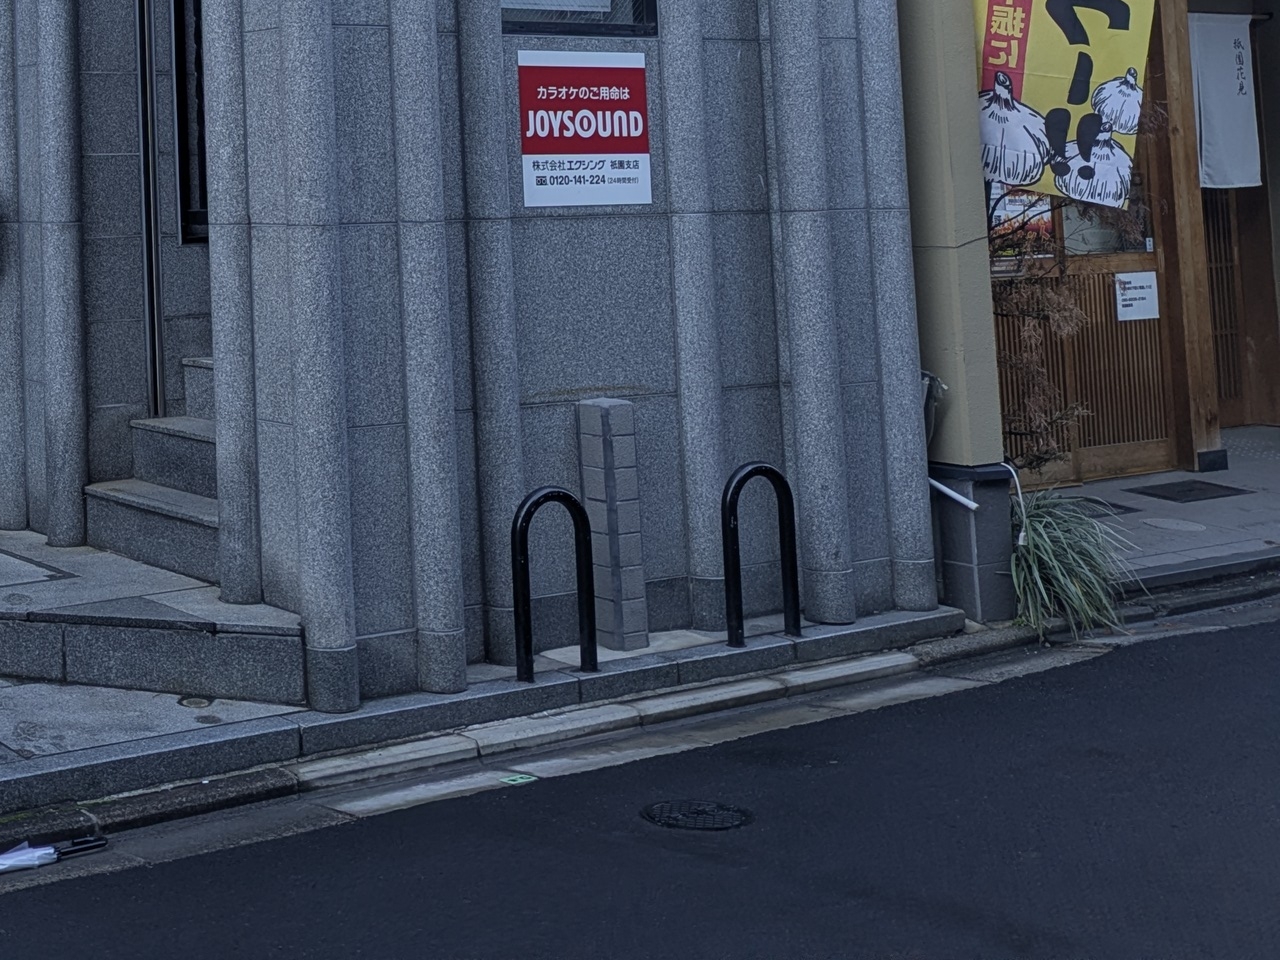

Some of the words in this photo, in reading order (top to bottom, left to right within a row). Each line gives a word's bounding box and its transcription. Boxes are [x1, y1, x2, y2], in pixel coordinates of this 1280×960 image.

[537, 86, 630, 100] カラオケのご用命は
[526, 109, 643, 138] JOYSOUND
[532, 159, 606, 171] 株式会社エクシング
[549, 174, 606, 186] 0120-141-224
